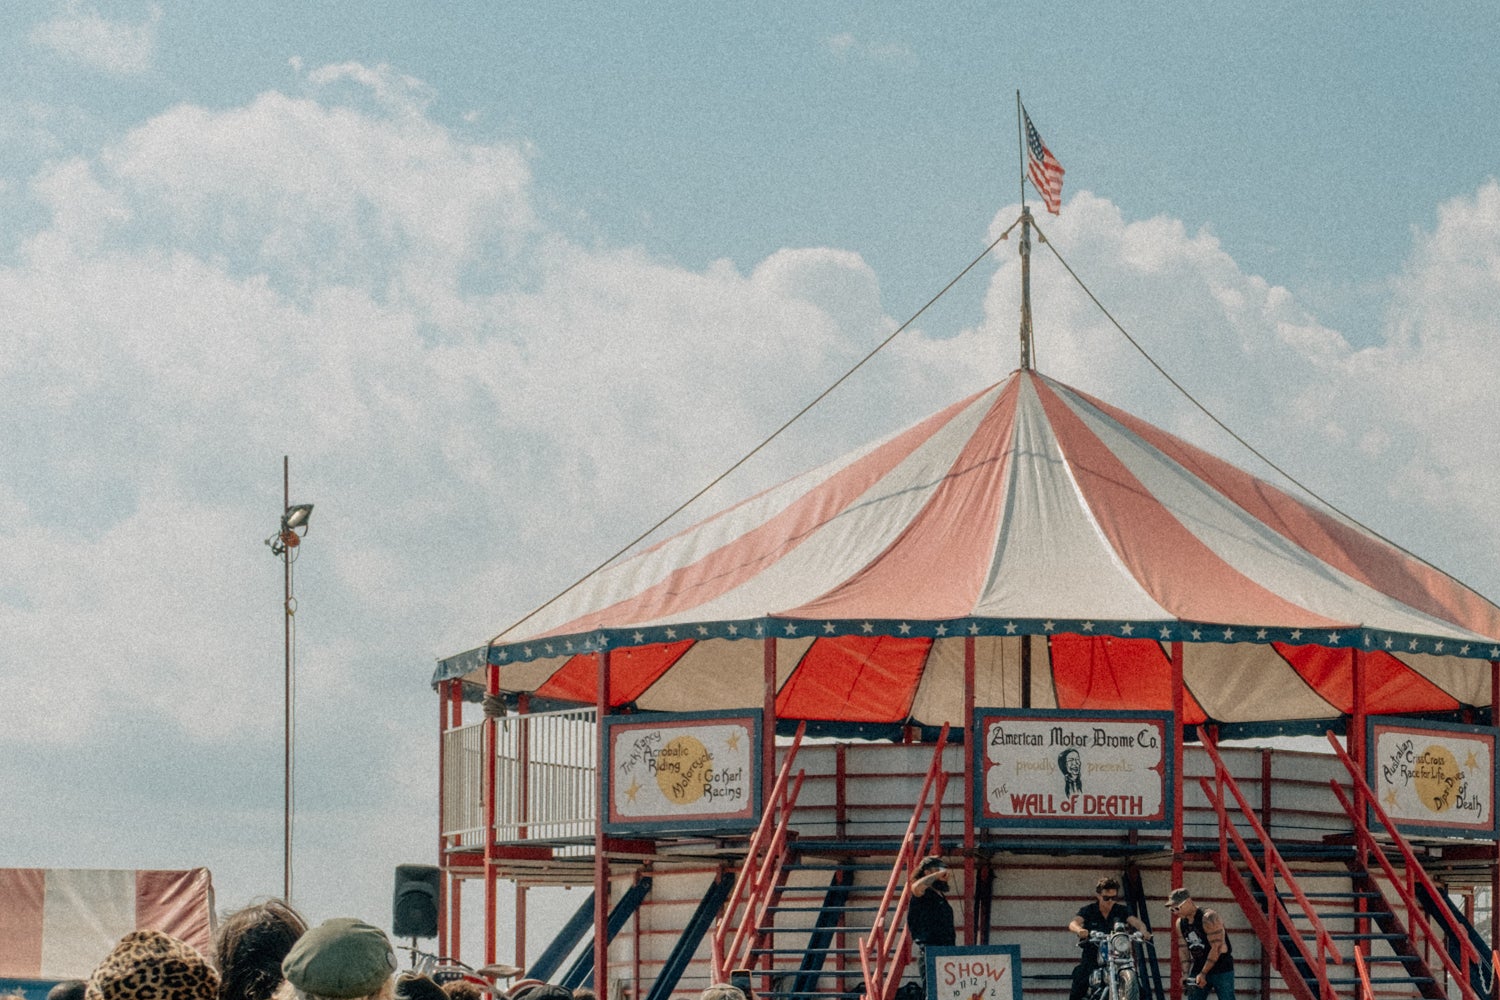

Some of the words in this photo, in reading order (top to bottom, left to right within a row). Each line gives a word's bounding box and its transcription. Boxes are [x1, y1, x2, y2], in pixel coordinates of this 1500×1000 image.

[633, 730, 662, 752] Fancy
[990, 726, 1044, 747] American
[1049, 726, 1089, 748] Motor
[1092, 727, 1135, 749] Drome
[1137, 728, 1159, 749] Co.
[643, 742, 690, 764] Acrobatic
[1382, 739, 1414, 785] Australian
[648, 758, 681, 777] Riding
[672, 748, 715, 799] Motorcycle
[1015, 758, 1057, 776] proudly
[1087, 759, 1135, 776] presents
[703, 783, 742, 803] Racing
[991, 783, 1009, 800] THE
[1458, 781, 1469, 801] of
[1010, 793, 1057, 817] WALL
[1083, 794, 1143, 817] DEATH
[1455, 794, 1483, 819] Death
[943, 961, 1007, 986] SHOW
[970, 977, 978, 986] 12
[953, 990, 961, 998] 10
[960, 980, 967, 989] 11
[990, 988, 997, 997] 2
